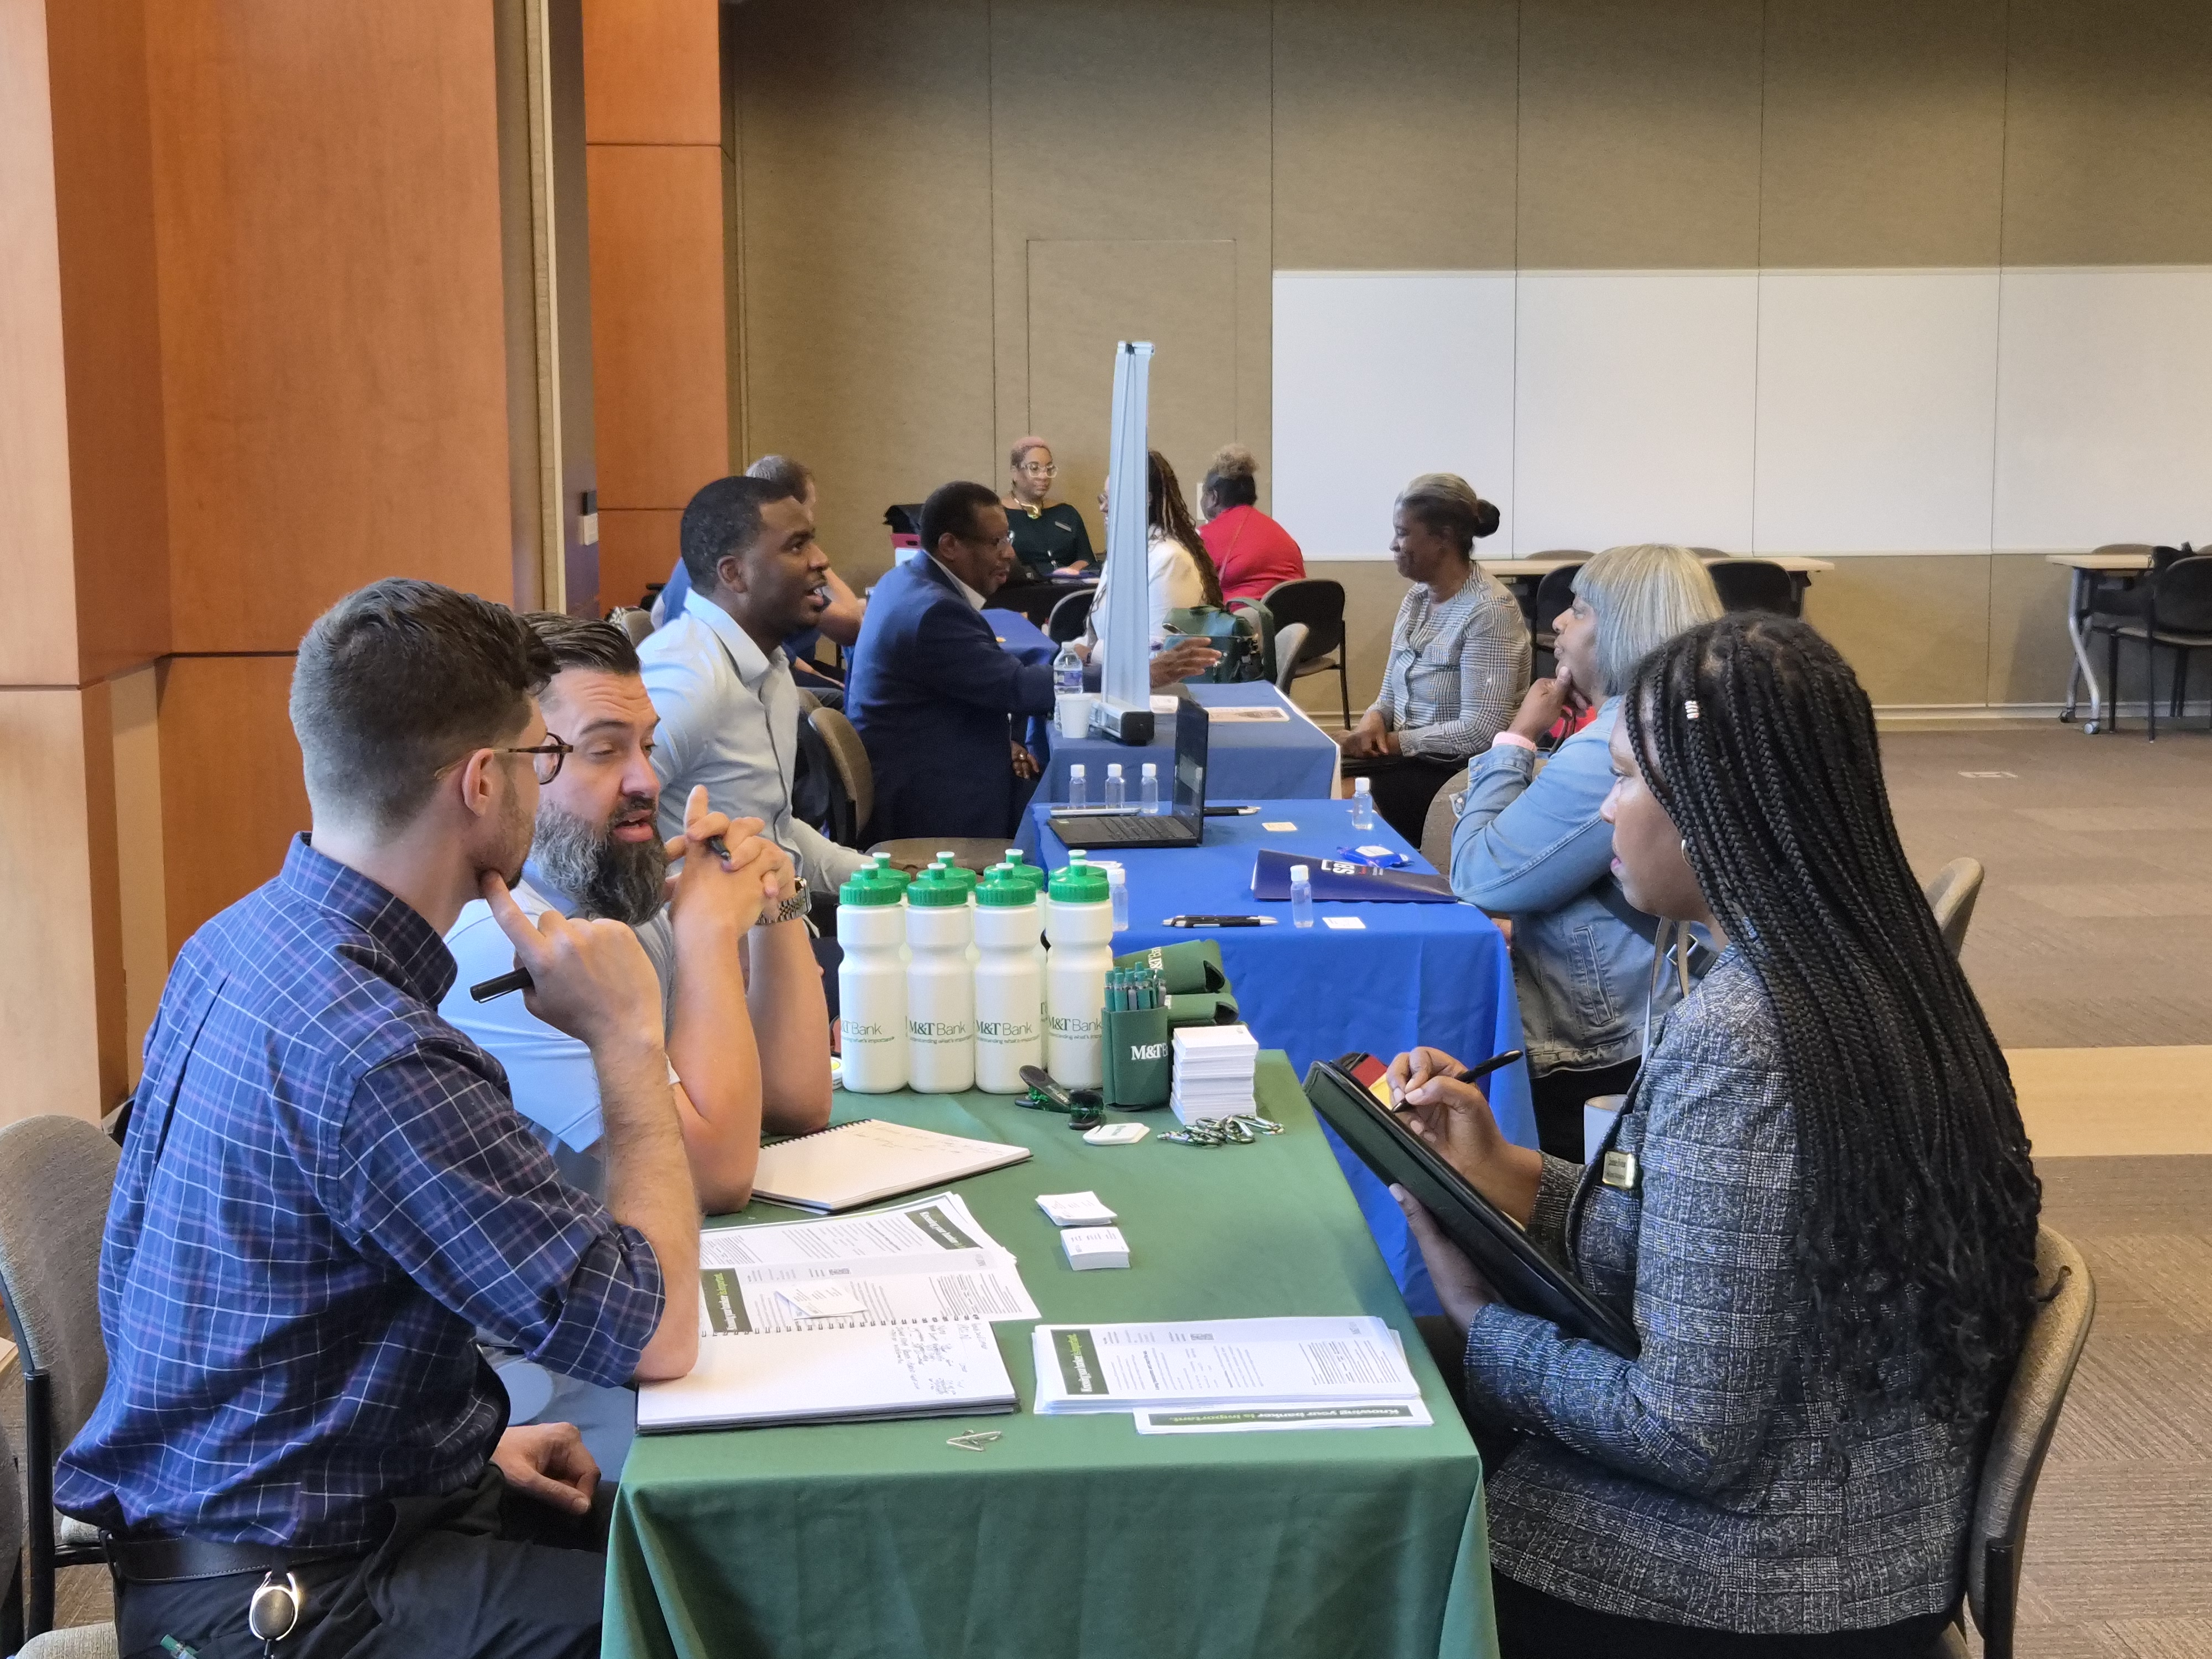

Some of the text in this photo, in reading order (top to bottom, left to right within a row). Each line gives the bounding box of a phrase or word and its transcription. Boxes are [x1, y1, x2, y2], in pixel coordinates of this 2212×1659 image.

[1333, 860, 1355, 874] SB
[852, 1022, 882, 1035] Bank
[910, 1020, 936, 1035] M&T
[937, 1021, 966, 1036] Bank
[976, 1019, 1032, 1036] M&T Bank
[1048, 1015, 1102, 1032] M&T Bank
[1131, 1044, 1162, 1060] M&T
